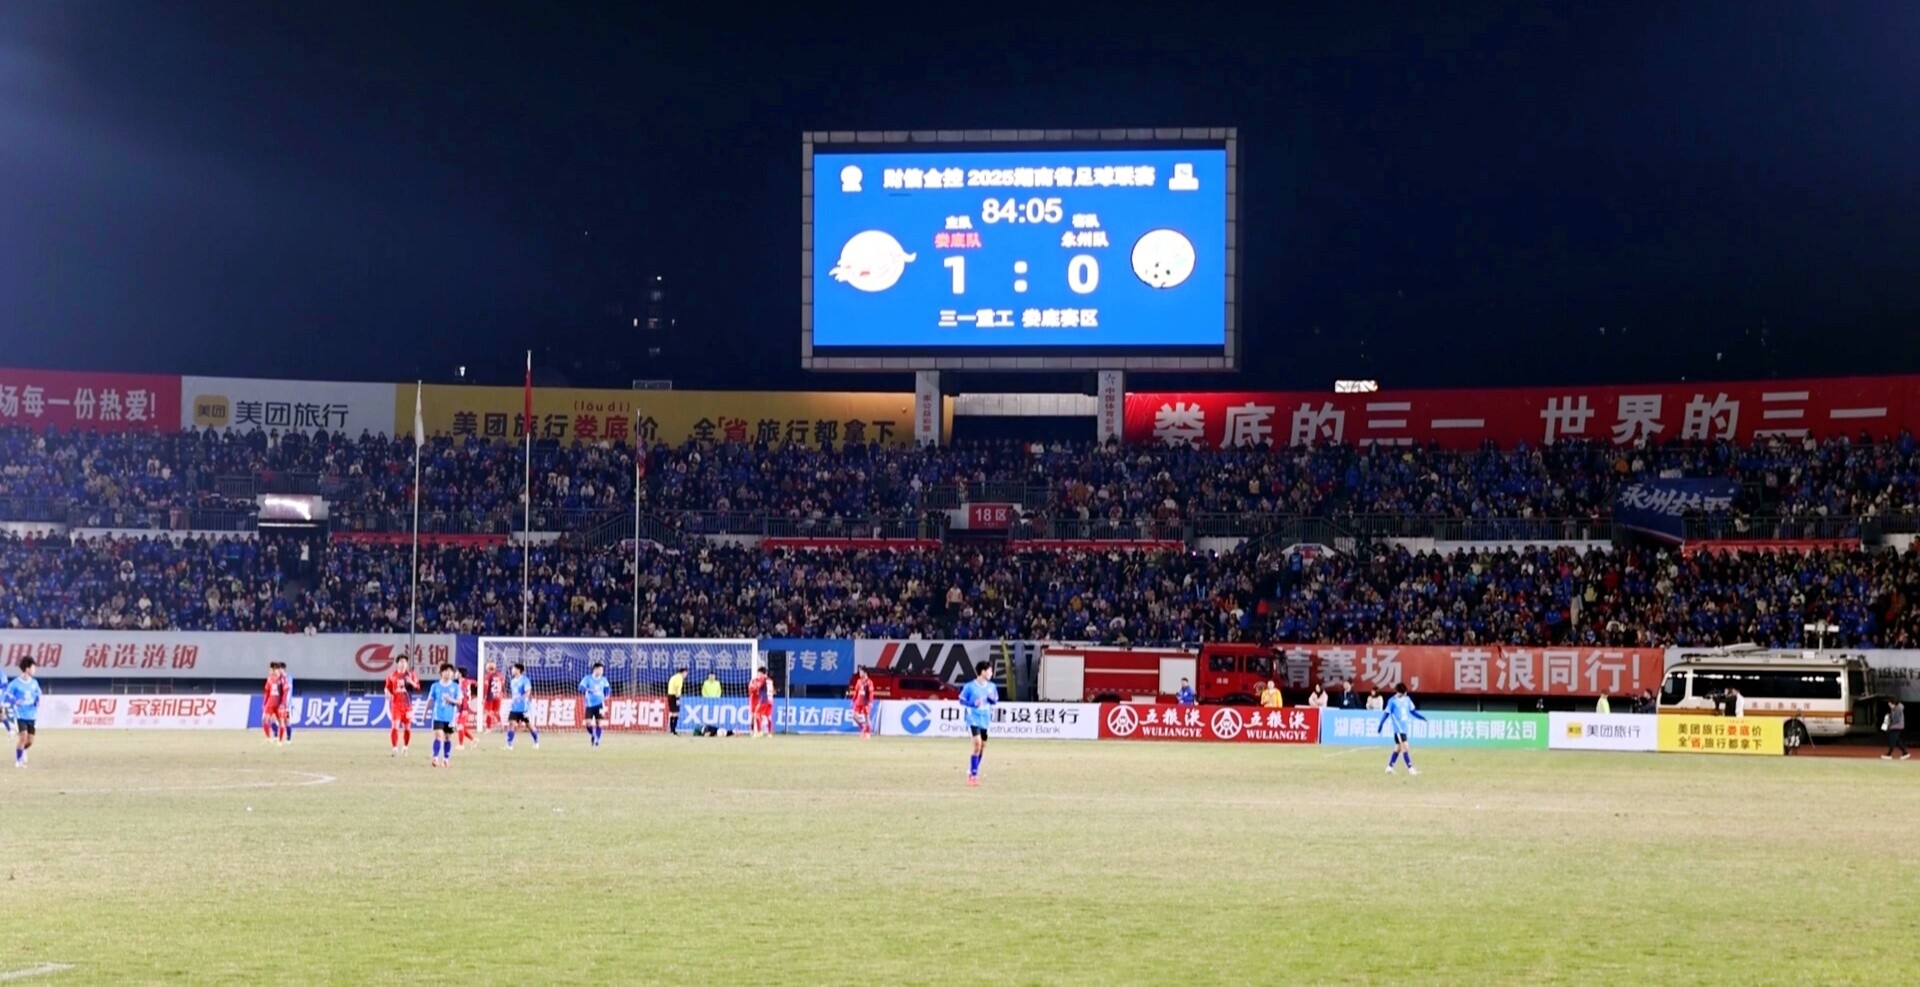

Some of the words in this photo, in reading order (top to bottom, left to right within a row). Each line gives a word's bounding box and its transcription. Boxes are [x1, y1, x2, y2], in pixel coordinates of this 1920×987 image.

[981, 197, 1063, 223] 84:05
[934, 232, 982, 249] 娄底队
[1061, 231, 1109, 248] 永州队
[943, 255, 966, 295] 1
[1067, 254, 1100, 294] 0
[938, 309, 1015, 328] 三一重工
[1021, 308, 1099, 328] 娄底赛区
[197, 403, 227, 418] 美团
[235, 399, 350, 428] 美团旅行
[1540, 391, 1887, 445] 世界的三一
[975, 507, 992, 522] 18
[82, 643, 199, 669] 就选涟钢
[127, 699, 217, 717] 家新旧改
[940, 707, 1079, 725] 中建设银行
[1139, 709, 1206, 728] 五粮液
[1243, 711, 1310, 730] 五粮液
[1036, 725, 1061, 734] Bank
[1143, 726, 1202, 738] WULIANGYE
[1247, 729, 1307, 741] WULIANGYE
[1587, 724, 1641, 738] 美团旅行
[1678, 723, 1762, 736] 美团旅行娄底价
